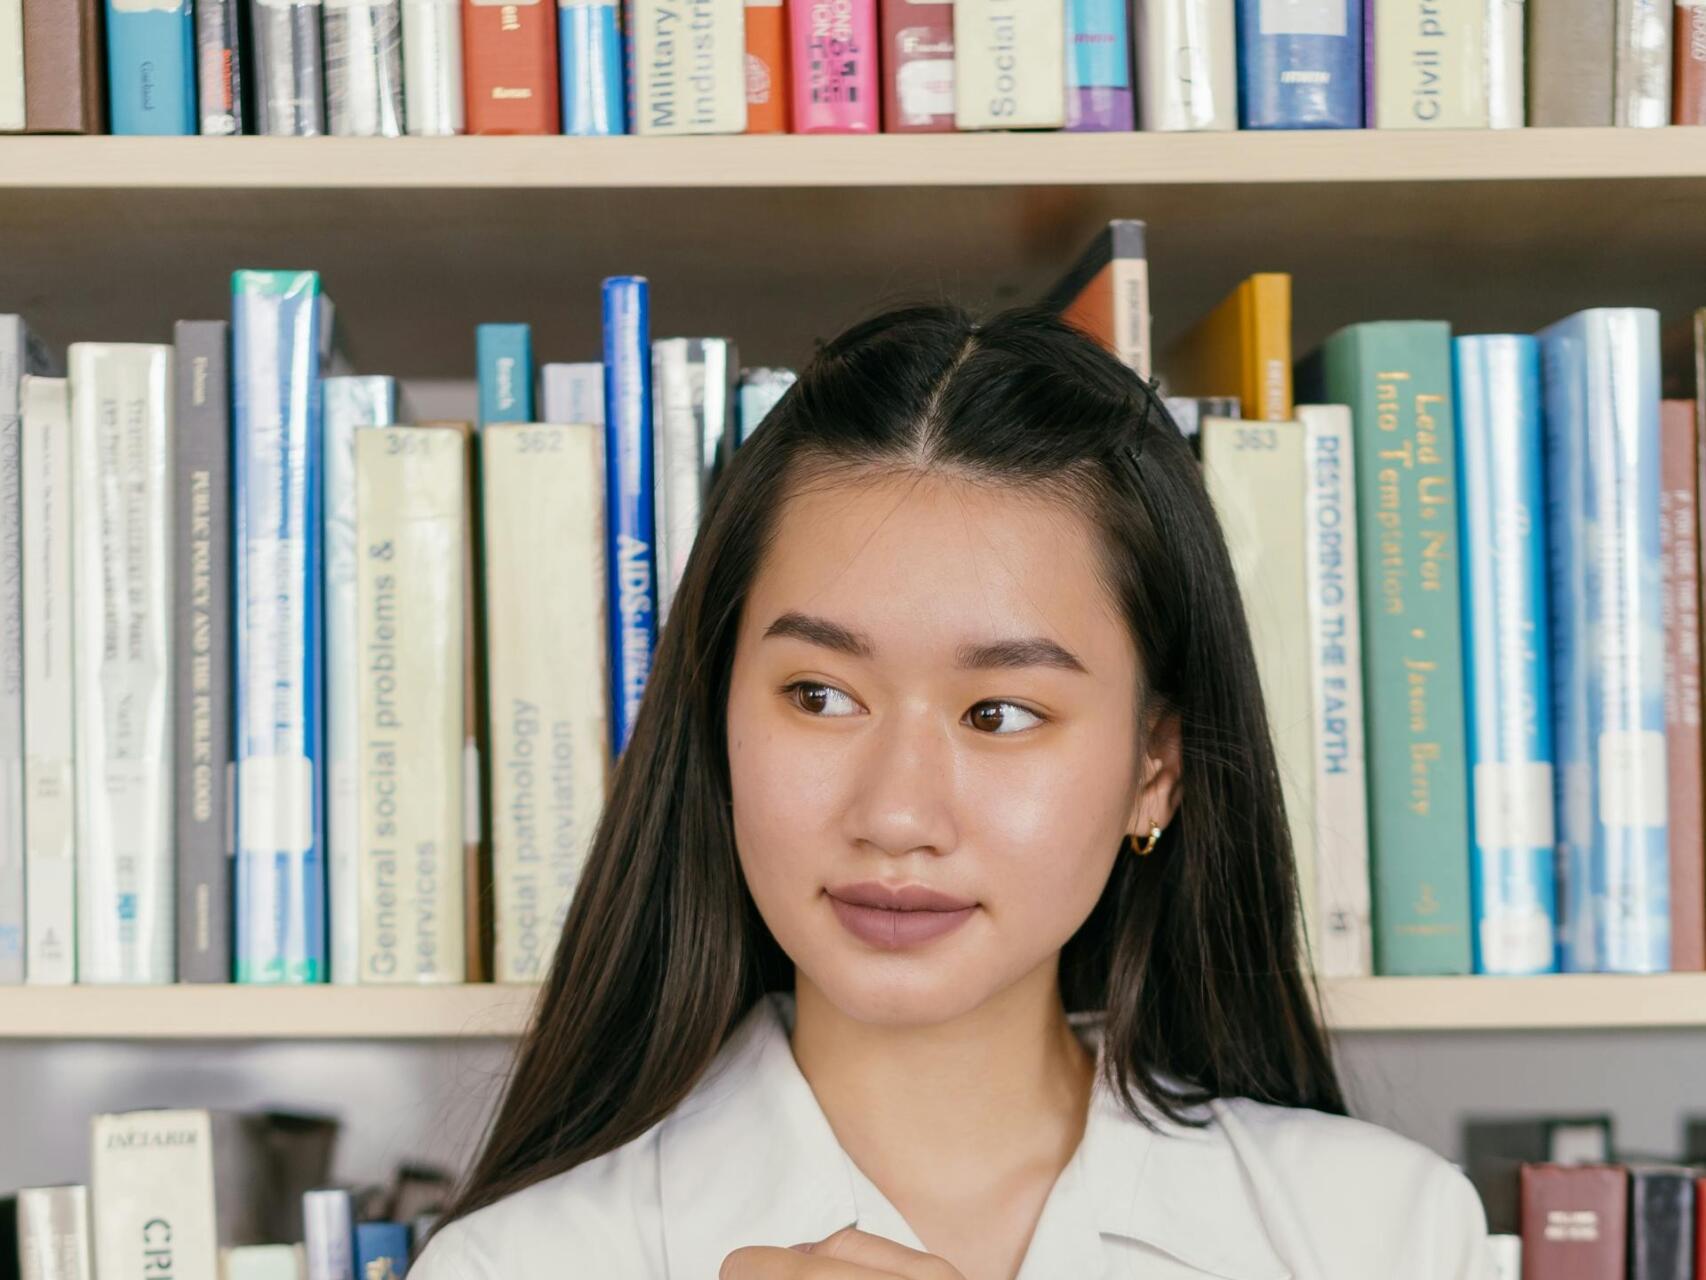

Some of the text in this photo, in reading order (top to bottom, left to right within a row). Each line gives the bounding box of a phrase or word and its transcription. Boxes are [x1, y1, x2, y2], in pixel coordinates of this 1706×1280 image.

[649, 7, 682, 128] Military
[987, 15, 1015, 118] Social
[1411, 50, 1440, 122] Civil
[385, 434, 431, 455] 361
[517, 430, 564, 453] 362
[1233, 428, 1278, 451] 363
[1376, 369, 1415, 614] Into Temptation
[1415, 392, 1450, 592] Lead Us Not
[192, 471, 211, 821] PUBLIC POLICY AND THE PUBLIC GOOD
[1316, 435, 1349, 774] RESTORING THE EARTH
[368, 539, 402, 972] General social problems &
[547, 720, 575, 888] alleviation
[1403, 657, 1441, 816] Jason Berry
[409, 840, 437, 973] services
[507, 698, 541, 974] Social pathology
